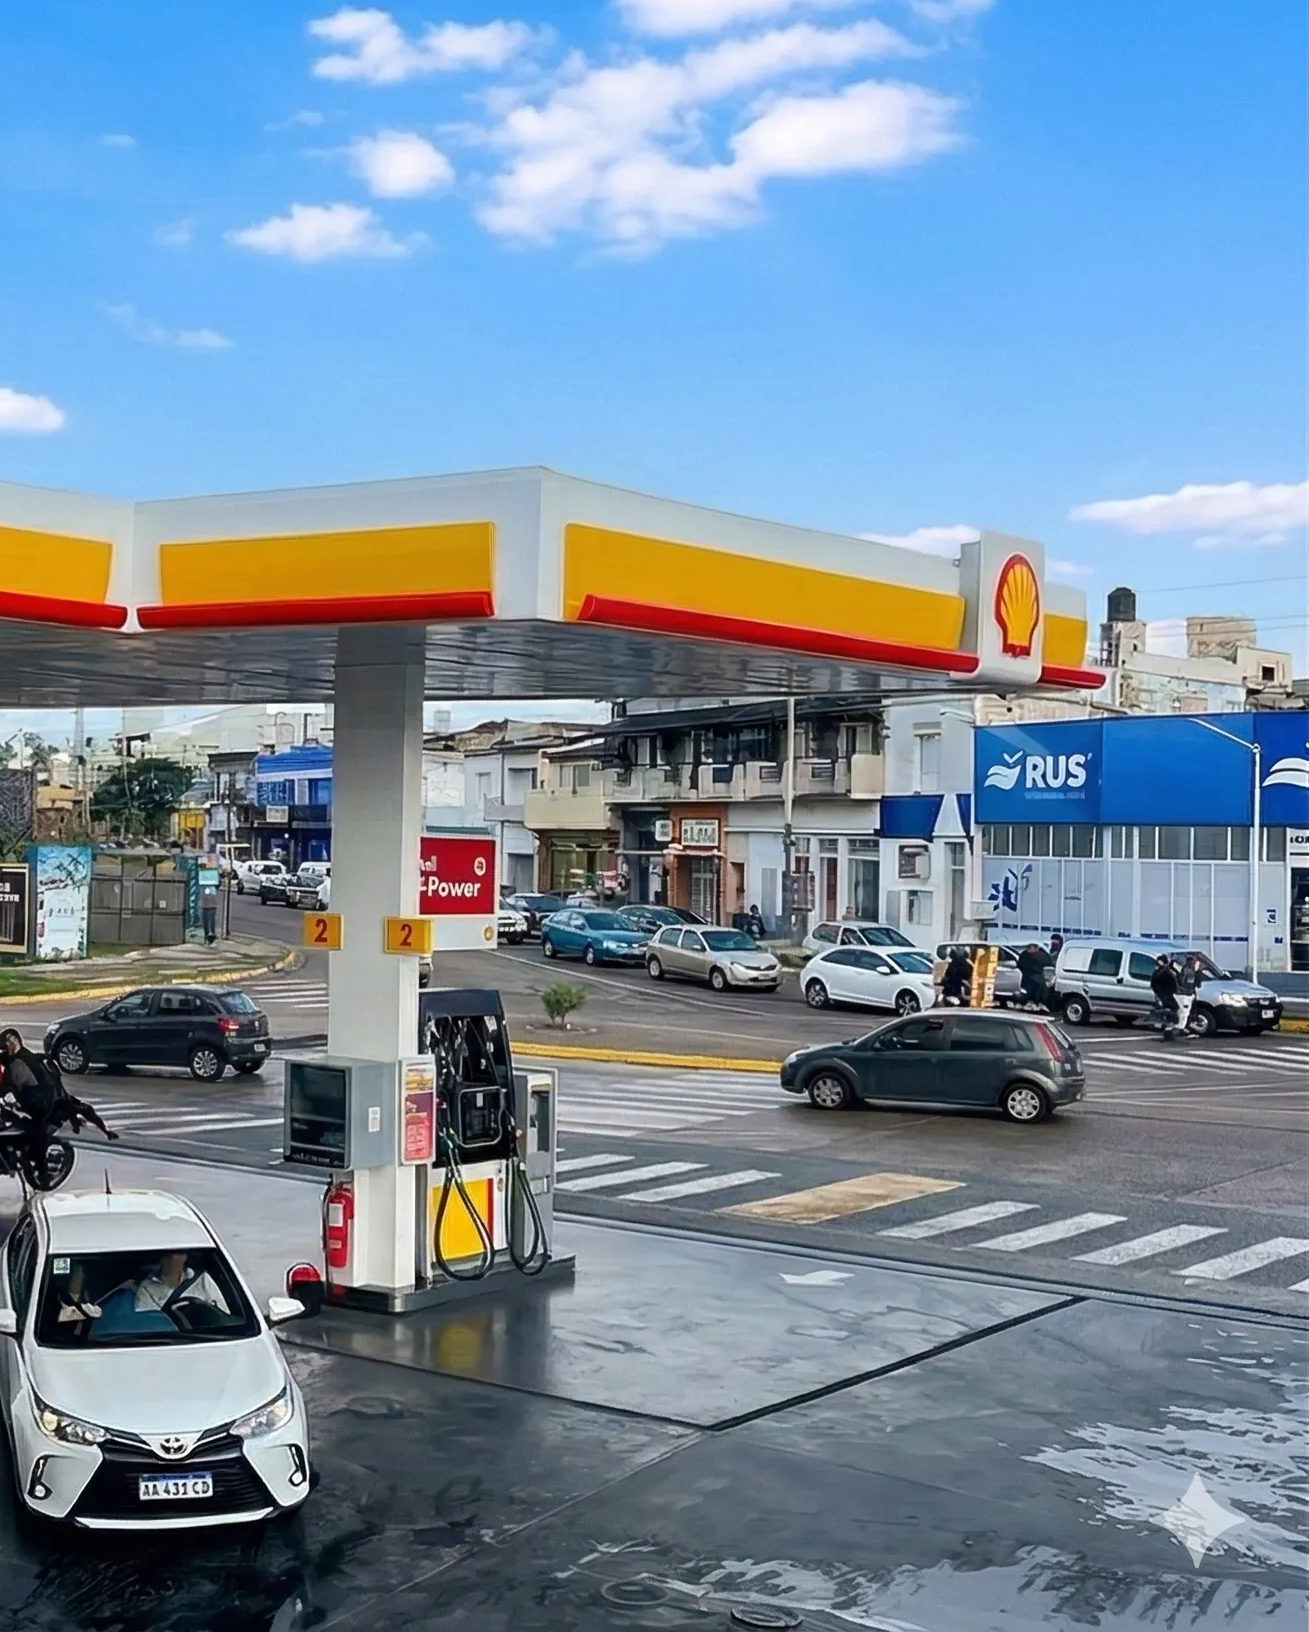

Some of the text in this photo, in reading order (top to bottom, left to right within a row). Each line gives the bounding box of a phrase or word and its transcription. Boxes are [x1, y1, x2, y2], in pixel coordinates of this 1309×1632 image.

[1025, 753, 1087, 789] RUS
[420, 875, 482, 898] -Power
[313, 917, 329, 944] 2
[399, 922, 413, 947] 2
[142, 1480, 211, 1497] AA 431 CD
